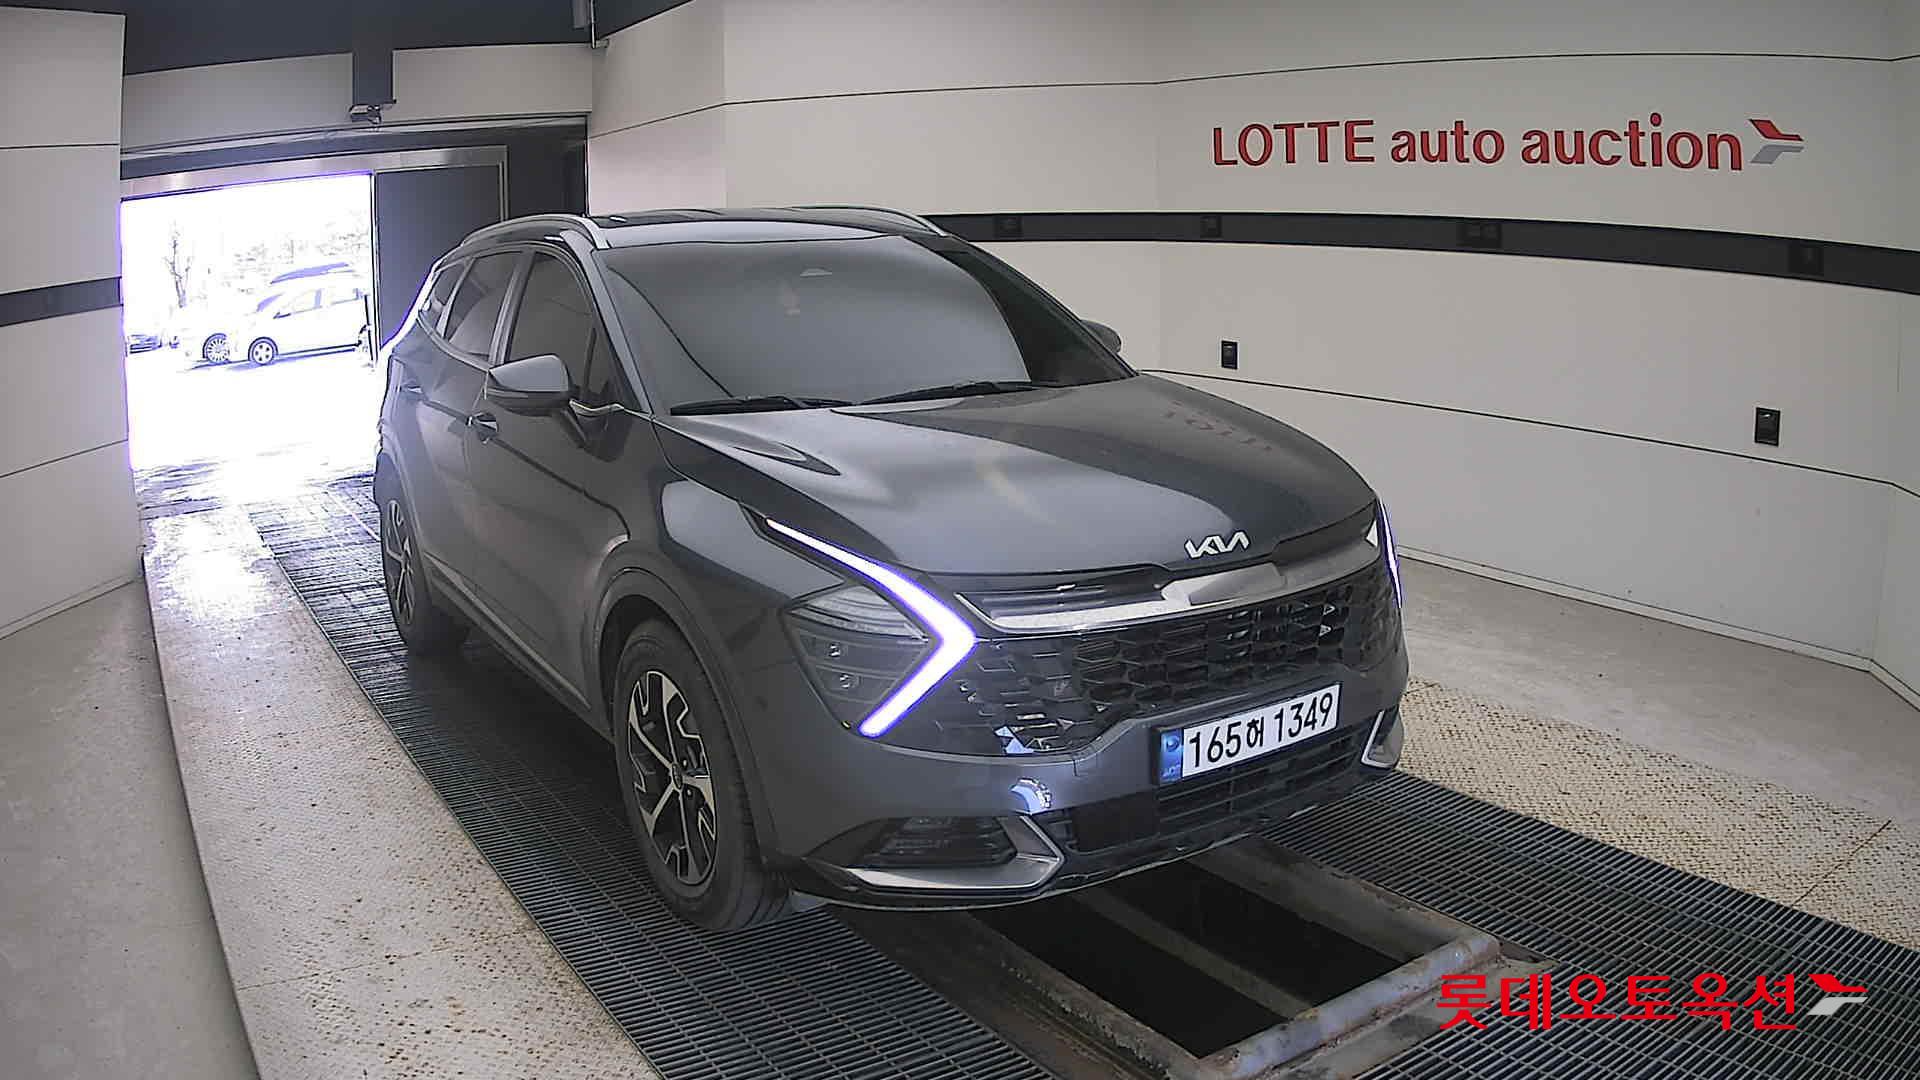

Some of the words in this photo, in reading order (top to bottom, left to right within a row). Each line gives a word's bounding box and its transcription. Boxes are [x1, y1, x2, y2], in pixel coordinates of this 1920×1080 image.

[1212, 120, 1374, 166] LOTTE
[1391, 119, 1505, 164] auto
[1521, 113, 1742, 171] auction
[1184, 531, 1249, 558] KIA
[1274, 692, 1333, 743] 1349
